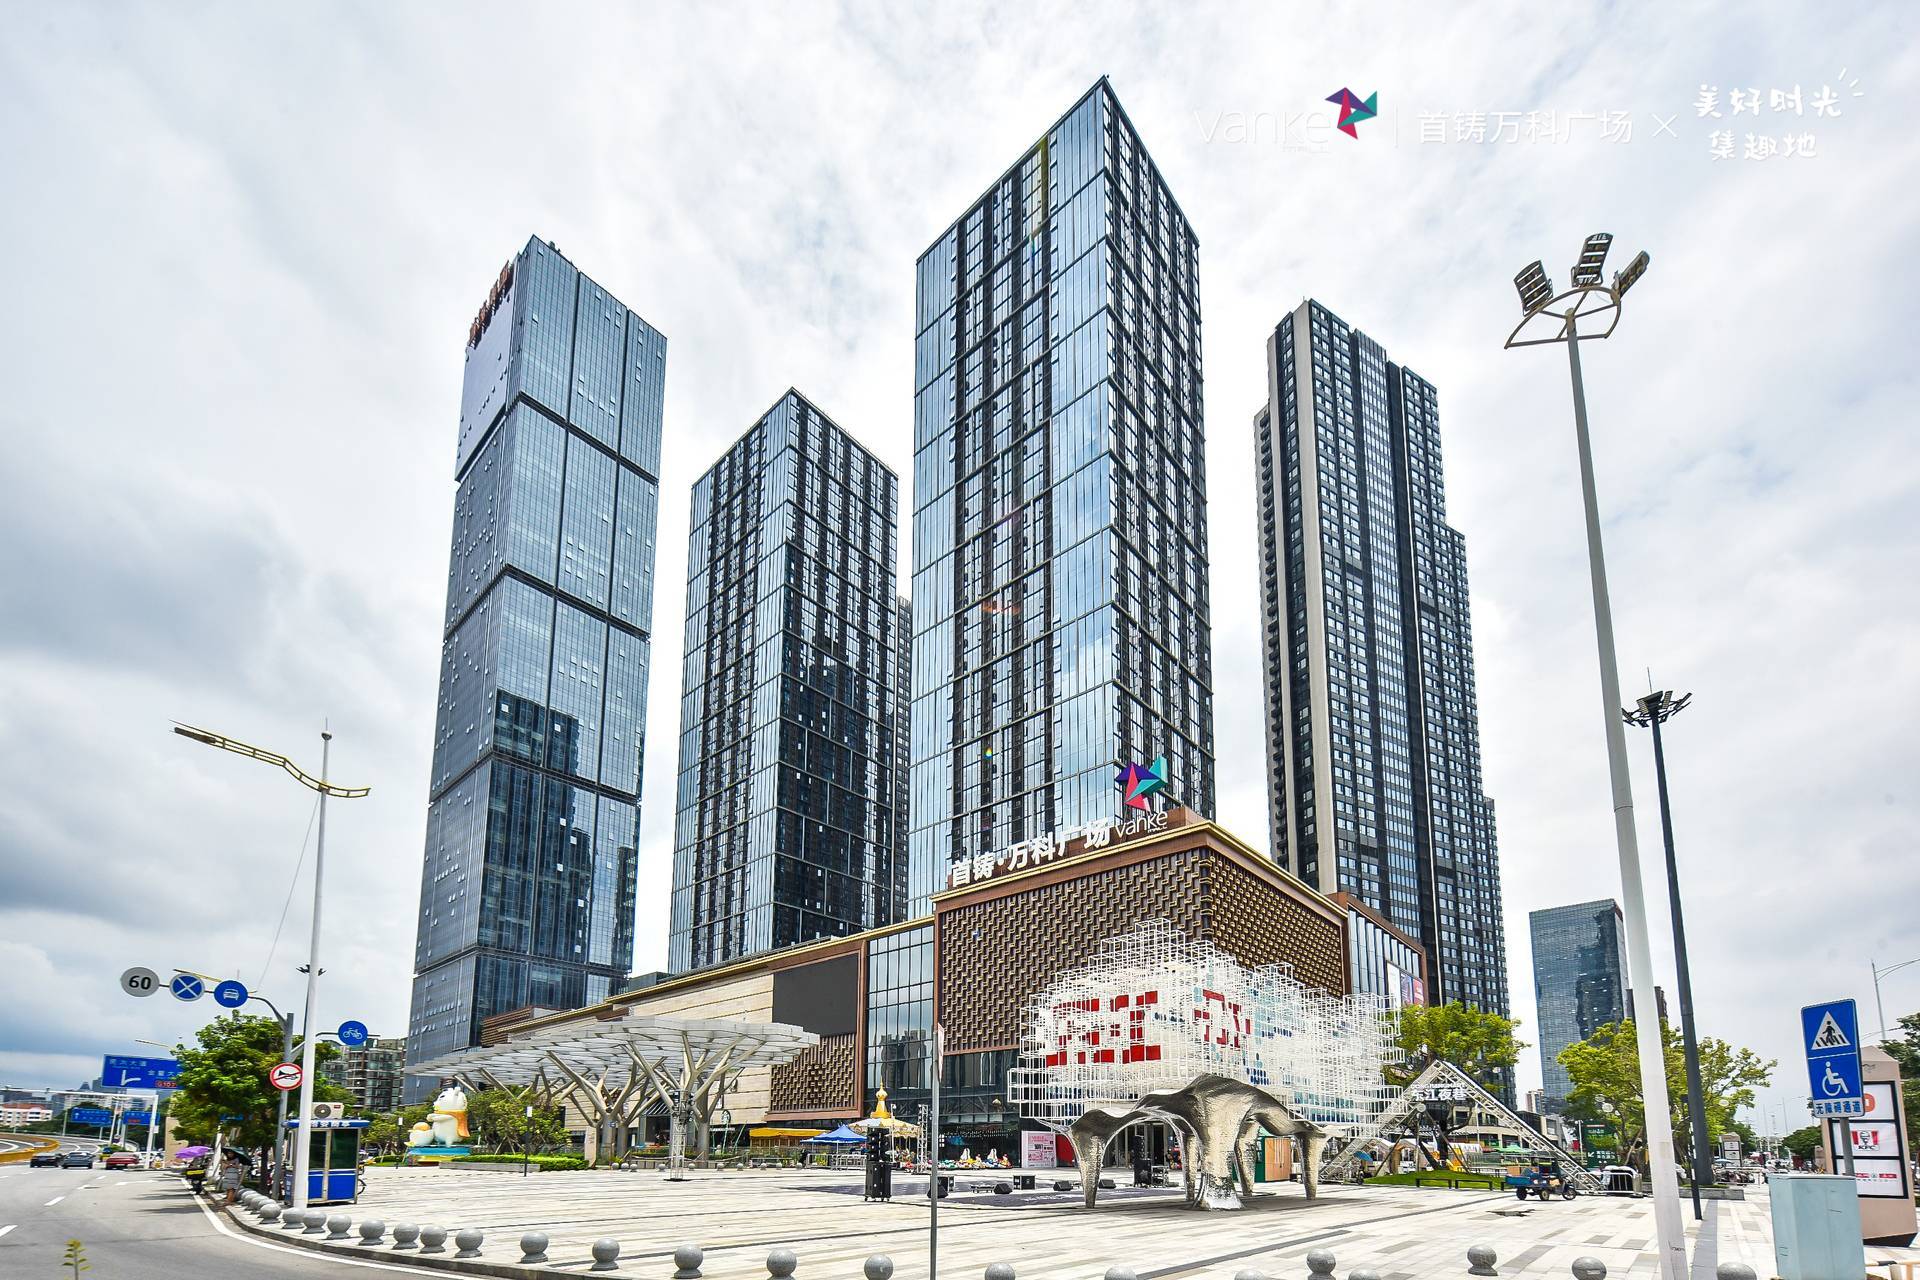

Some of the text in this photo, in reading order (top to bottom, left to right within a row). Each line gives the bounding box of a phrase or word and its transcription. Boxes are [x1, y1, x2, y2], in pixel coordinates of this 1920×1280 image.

[1115, 810, 1168, 839] vanke
[129, 975, 151, 990] 60
[1411, 1088, 1468, 1101] 东江夜巷
[1815, 1101, 1862, 1115] 无障碍通道
